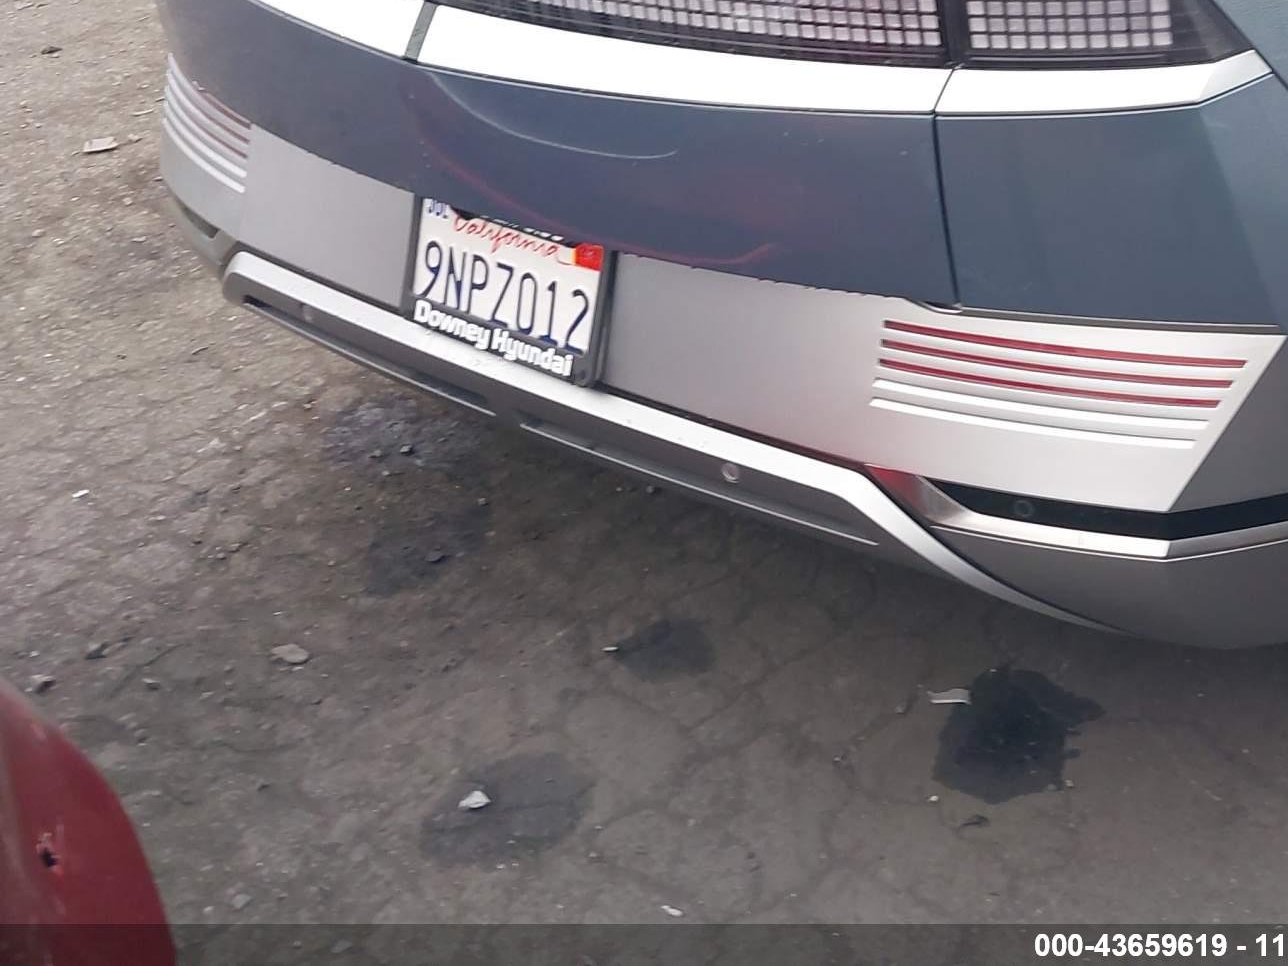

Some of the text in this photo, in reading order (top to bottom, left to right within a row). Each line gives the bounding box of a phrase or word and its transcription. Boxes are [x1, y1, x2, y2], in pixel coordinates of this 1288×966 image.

[414, 299, 574, 376] Downey Hyundai
[417, 240, 590, 355] 9NPZ012
